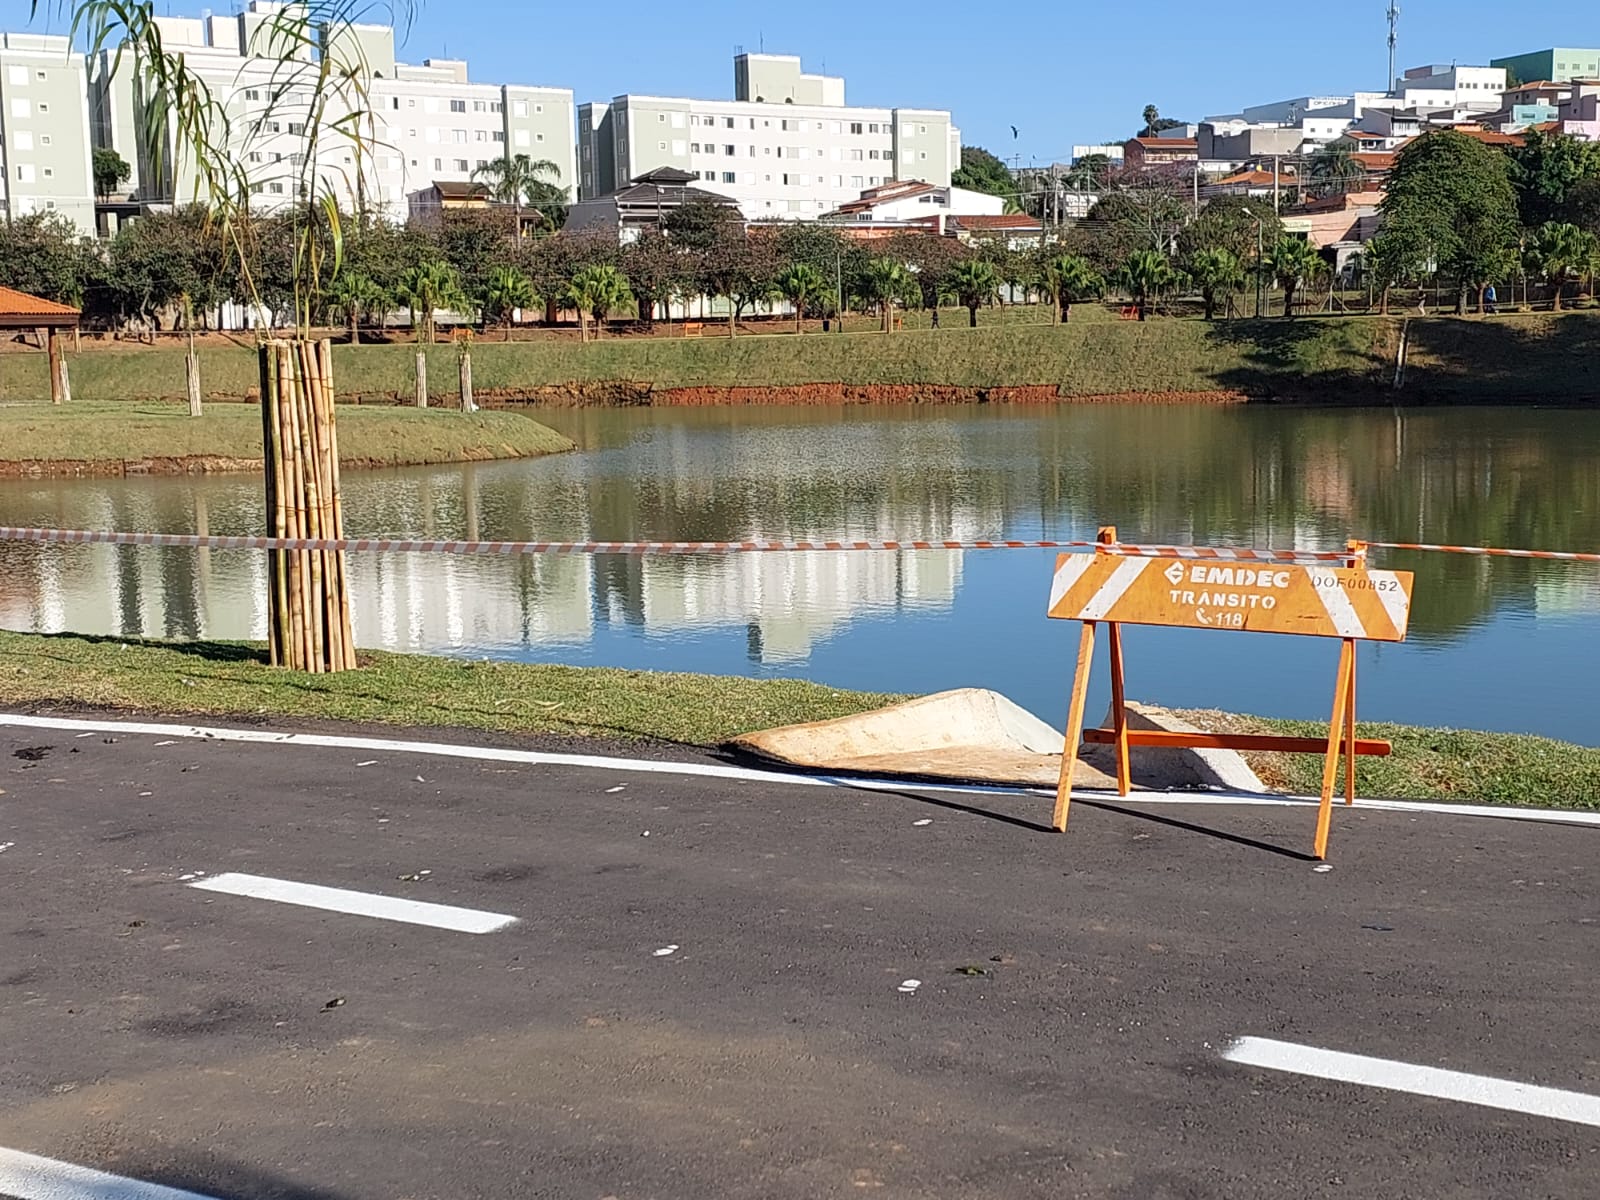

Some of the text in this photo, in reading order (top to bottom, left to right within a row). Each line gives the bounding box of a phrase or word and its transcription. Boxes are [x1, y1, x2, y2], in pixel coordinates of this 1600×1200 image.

[1190, 566, 1290, 588] EMDEC
[1169, 589, 1276, 609] TRÂNSITO
[1215, 612, 1243, 627] 118
